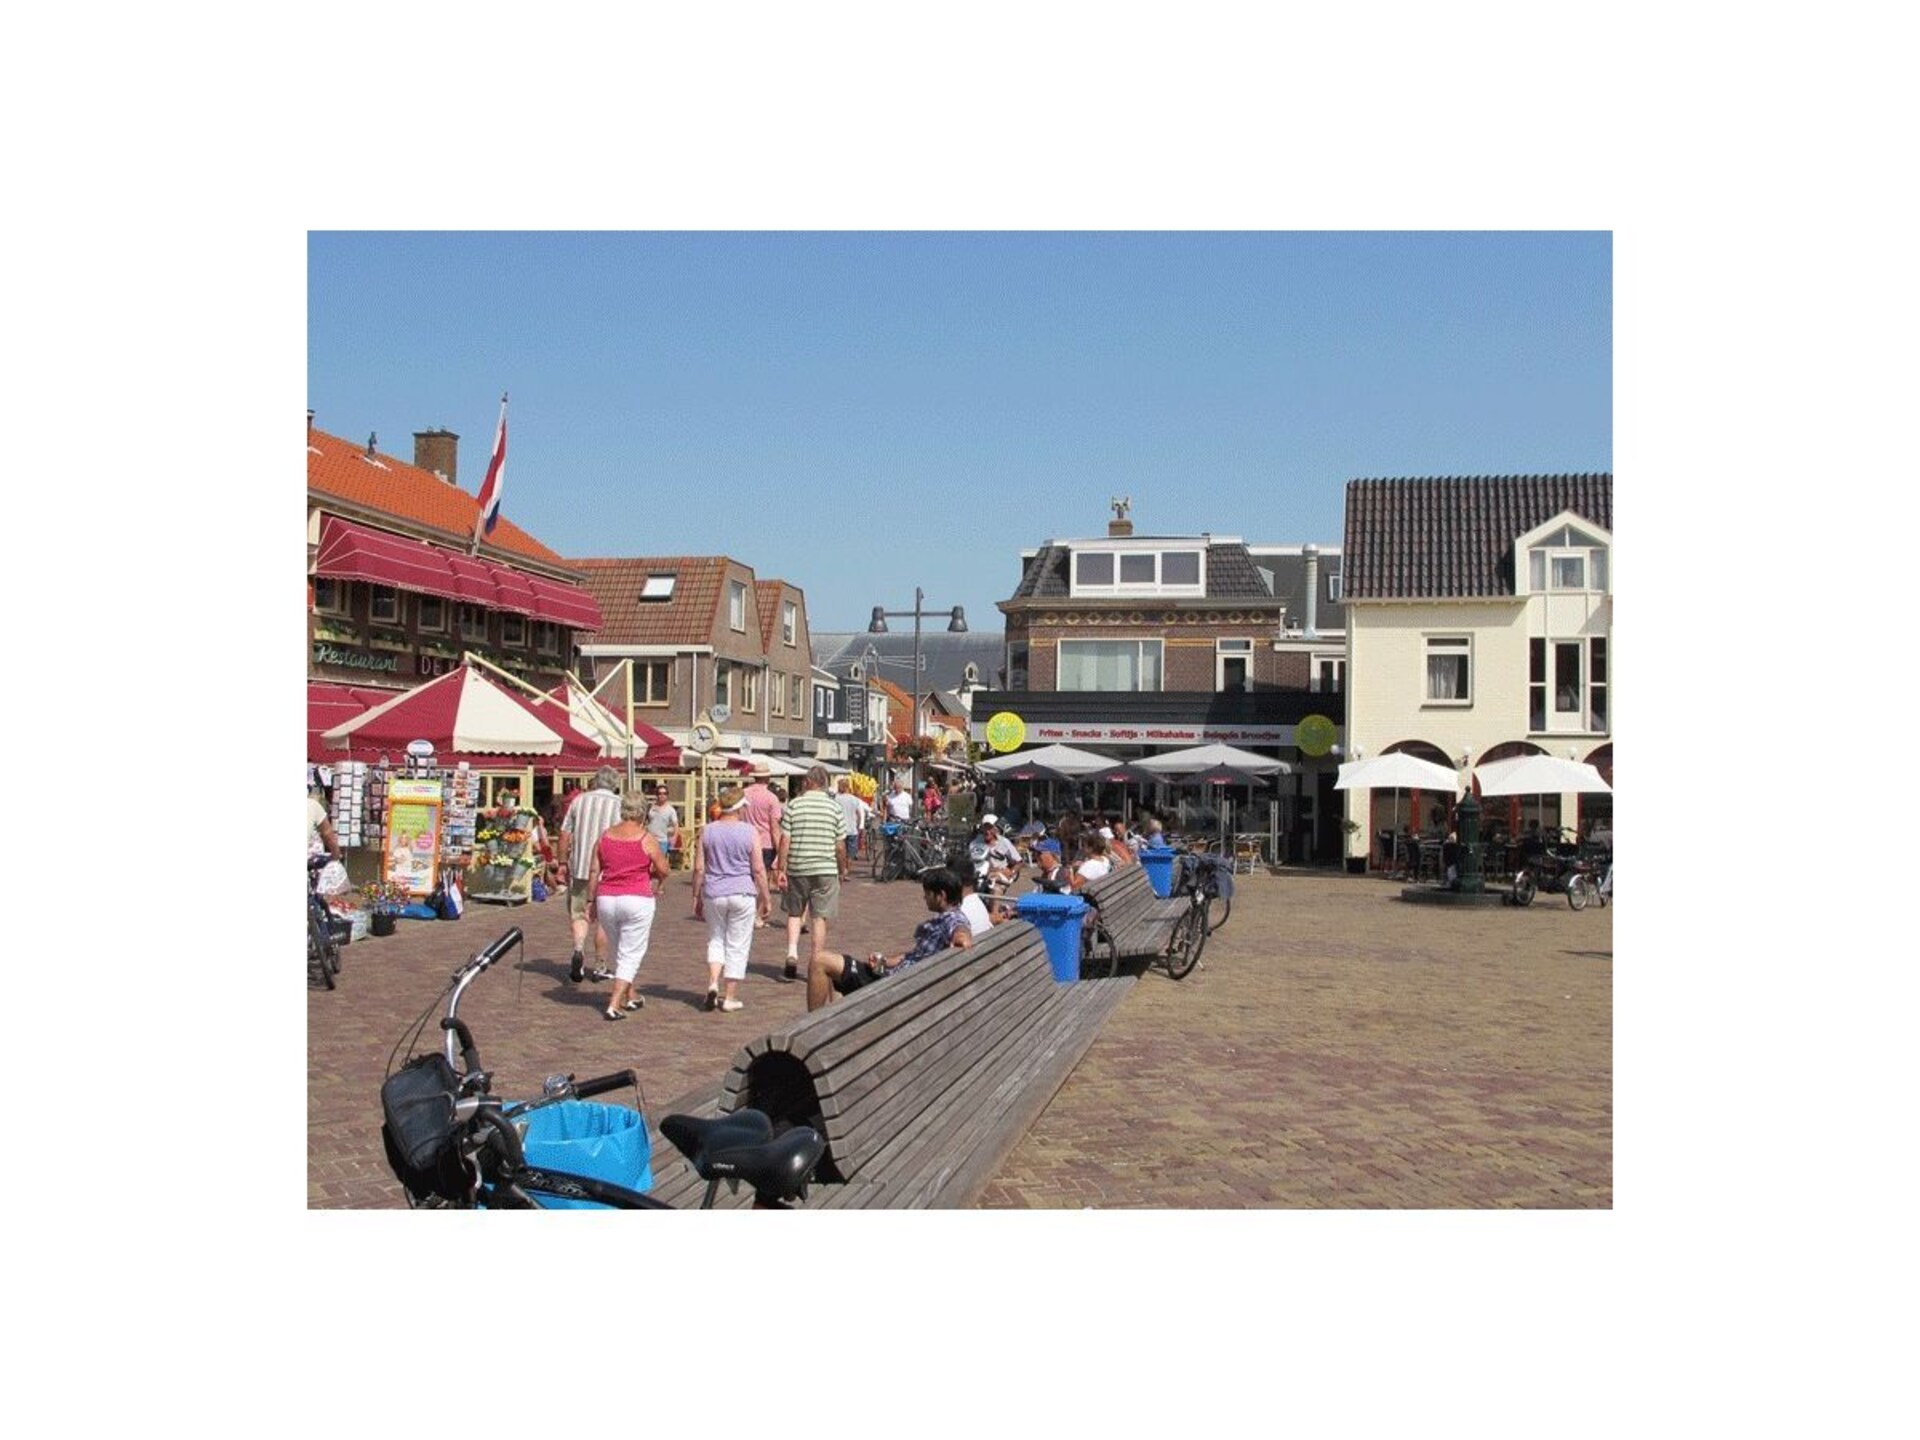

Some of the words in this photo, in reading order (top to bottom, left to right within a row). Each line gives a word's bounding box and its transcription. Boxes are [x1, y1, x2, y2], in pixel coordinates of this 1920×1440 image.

[316, 643, 398, 671] Restaurant
[421, 655, 442, 676] DE
[1039, 728, 1064, 738] Frites
[1071, 729, 1102, 739] Snacks
[1146, 729, 1196, 740] Milkshakes
[1240, 730, 1281, 741] Broodjes
